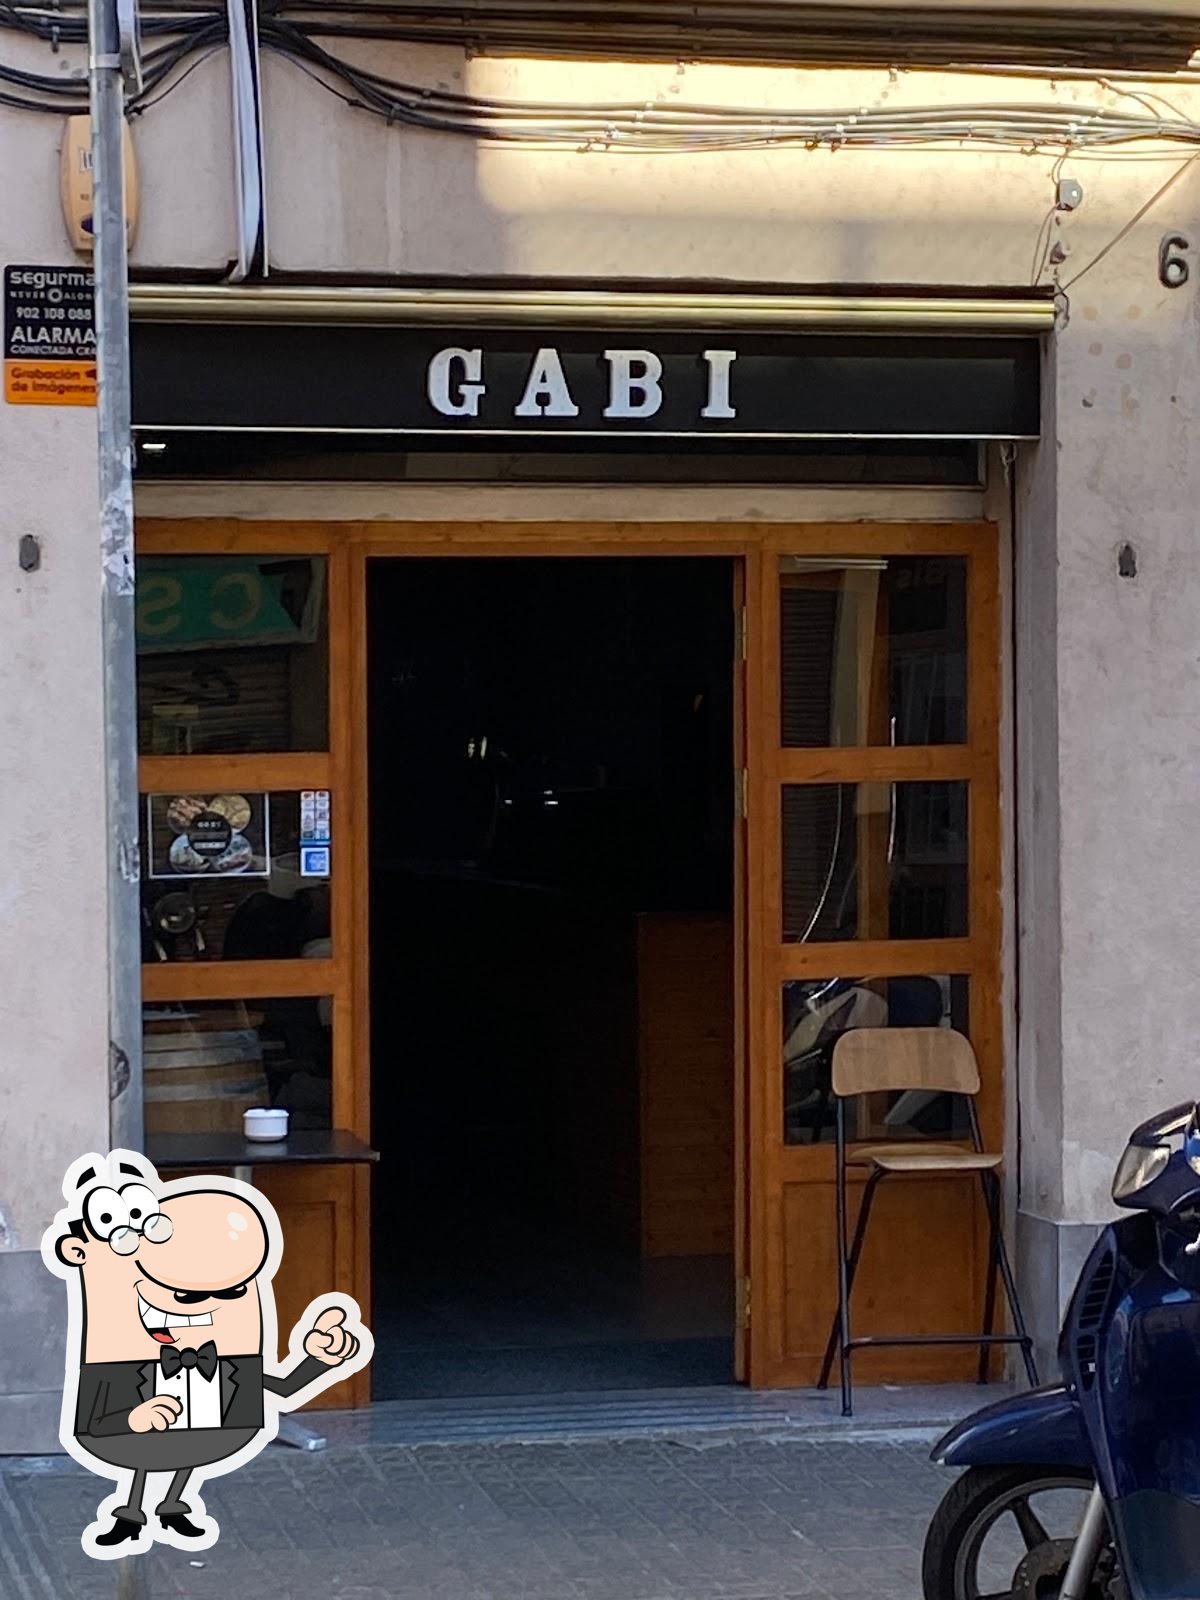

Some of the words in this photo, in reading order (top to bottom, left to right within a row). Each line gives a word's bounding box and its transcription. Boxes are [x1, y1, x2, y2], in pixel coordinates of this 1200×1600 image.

[1158, 231, 1189, 289] 6
[16, 306, 40, 319] 902
[11, 326, 97, 344] ALARMA
[10, 345, 74, 355] CONECTADA
[11, 367, 81, 380] Grabación
[11, 381, 28, 392] de
[427, 347, 737, 418] GABI
